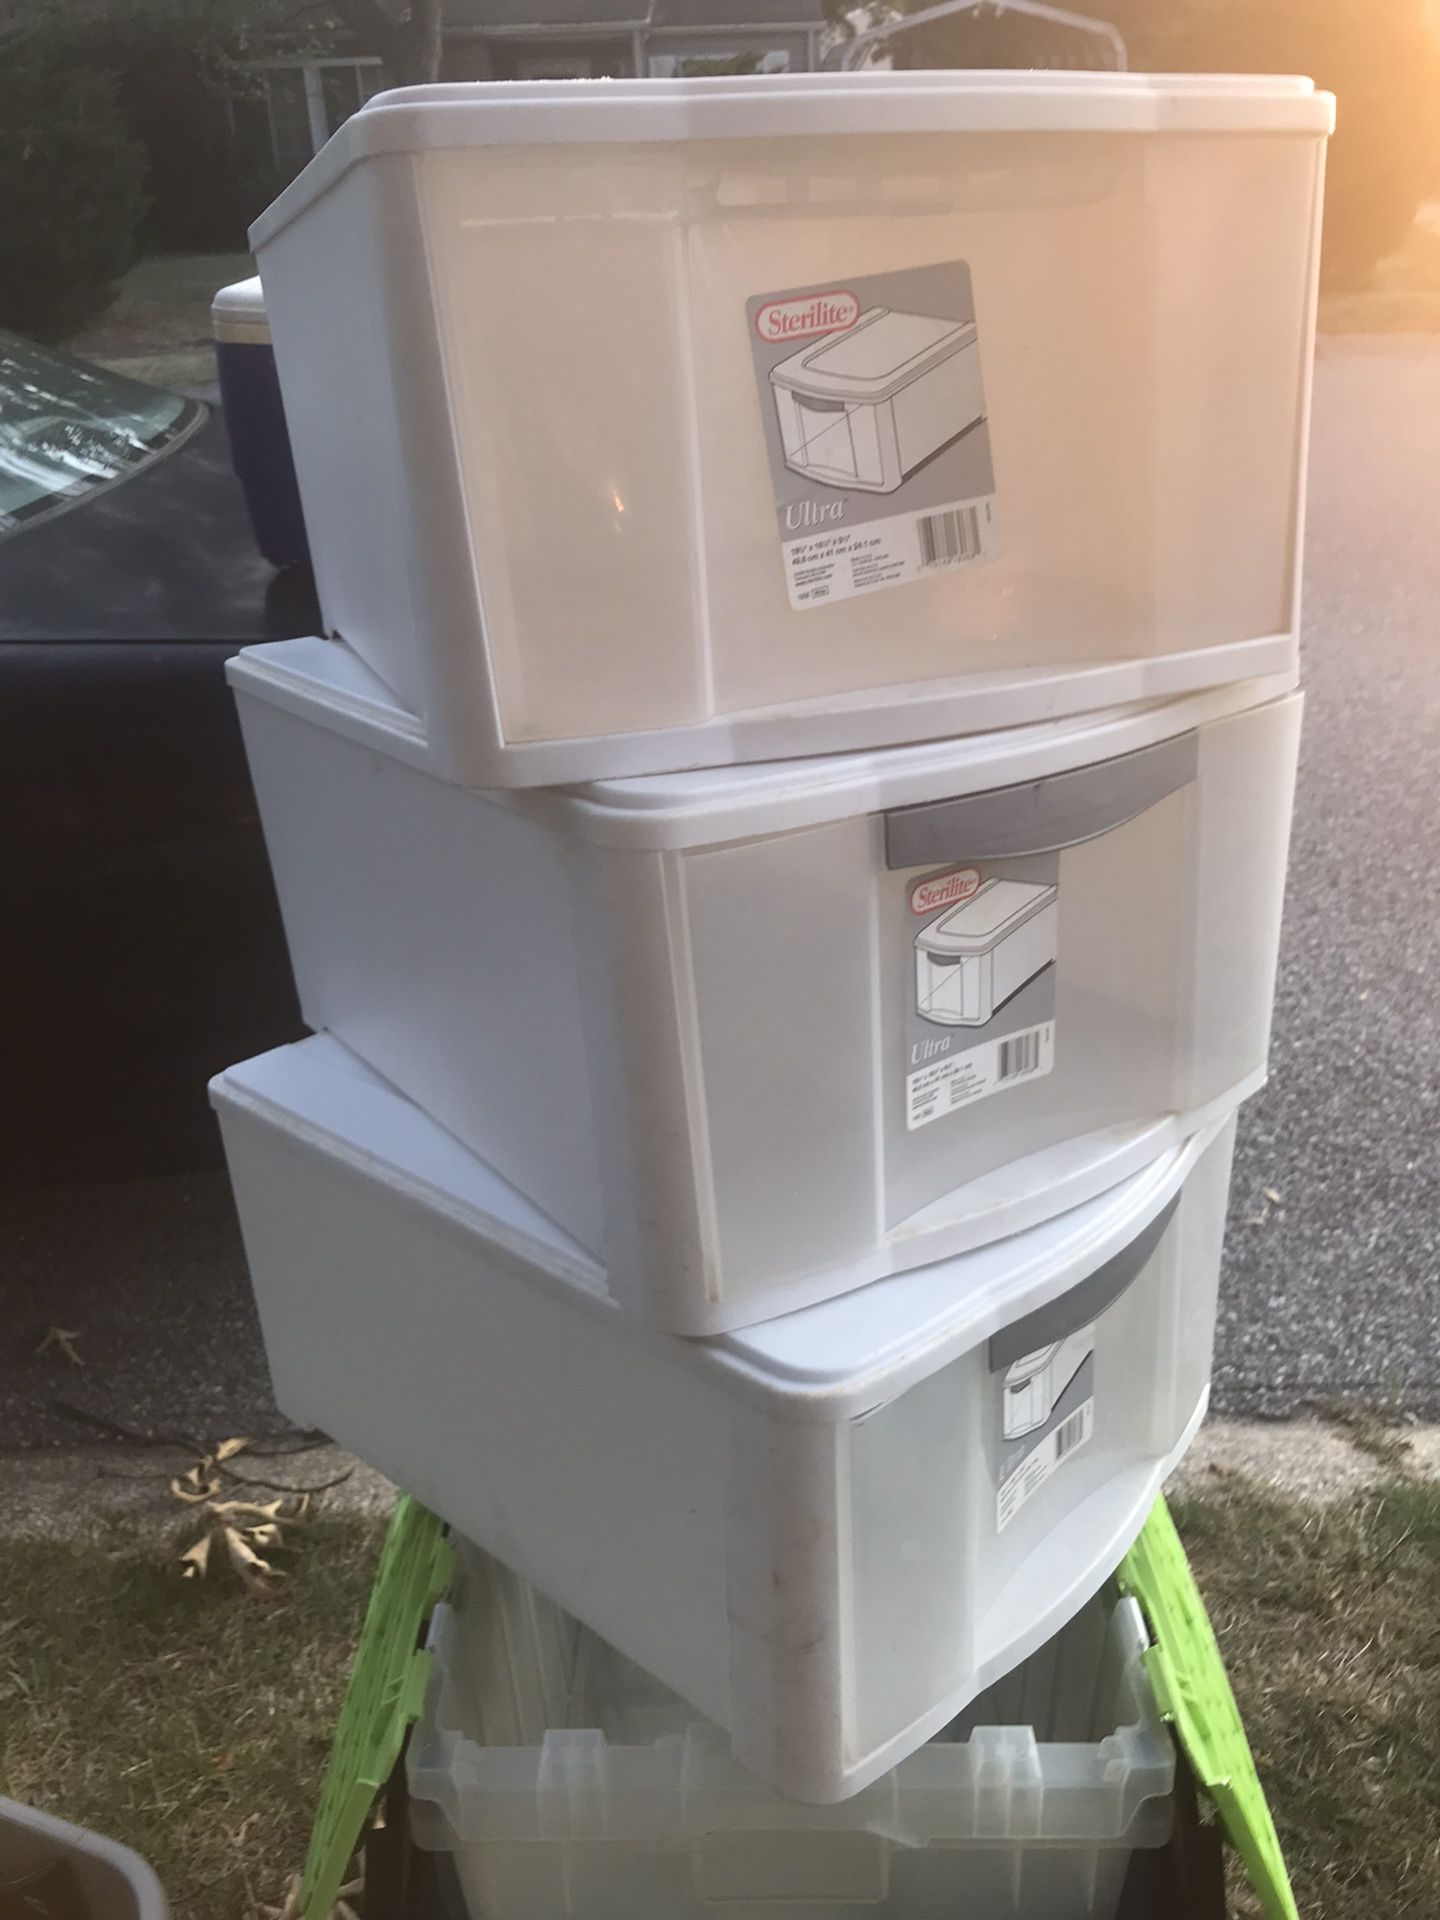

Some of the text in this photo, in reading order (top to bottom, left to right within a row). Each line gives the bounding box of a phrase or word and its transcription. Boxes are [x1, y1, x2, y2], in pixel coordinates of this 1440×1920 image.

[767, 301, 849, 336] Sterilite
[786, 500, 844, 530] Ultra
[917, 876, 971, 909] Sterilite
[911, 1036, 951, 1065] Ultra
